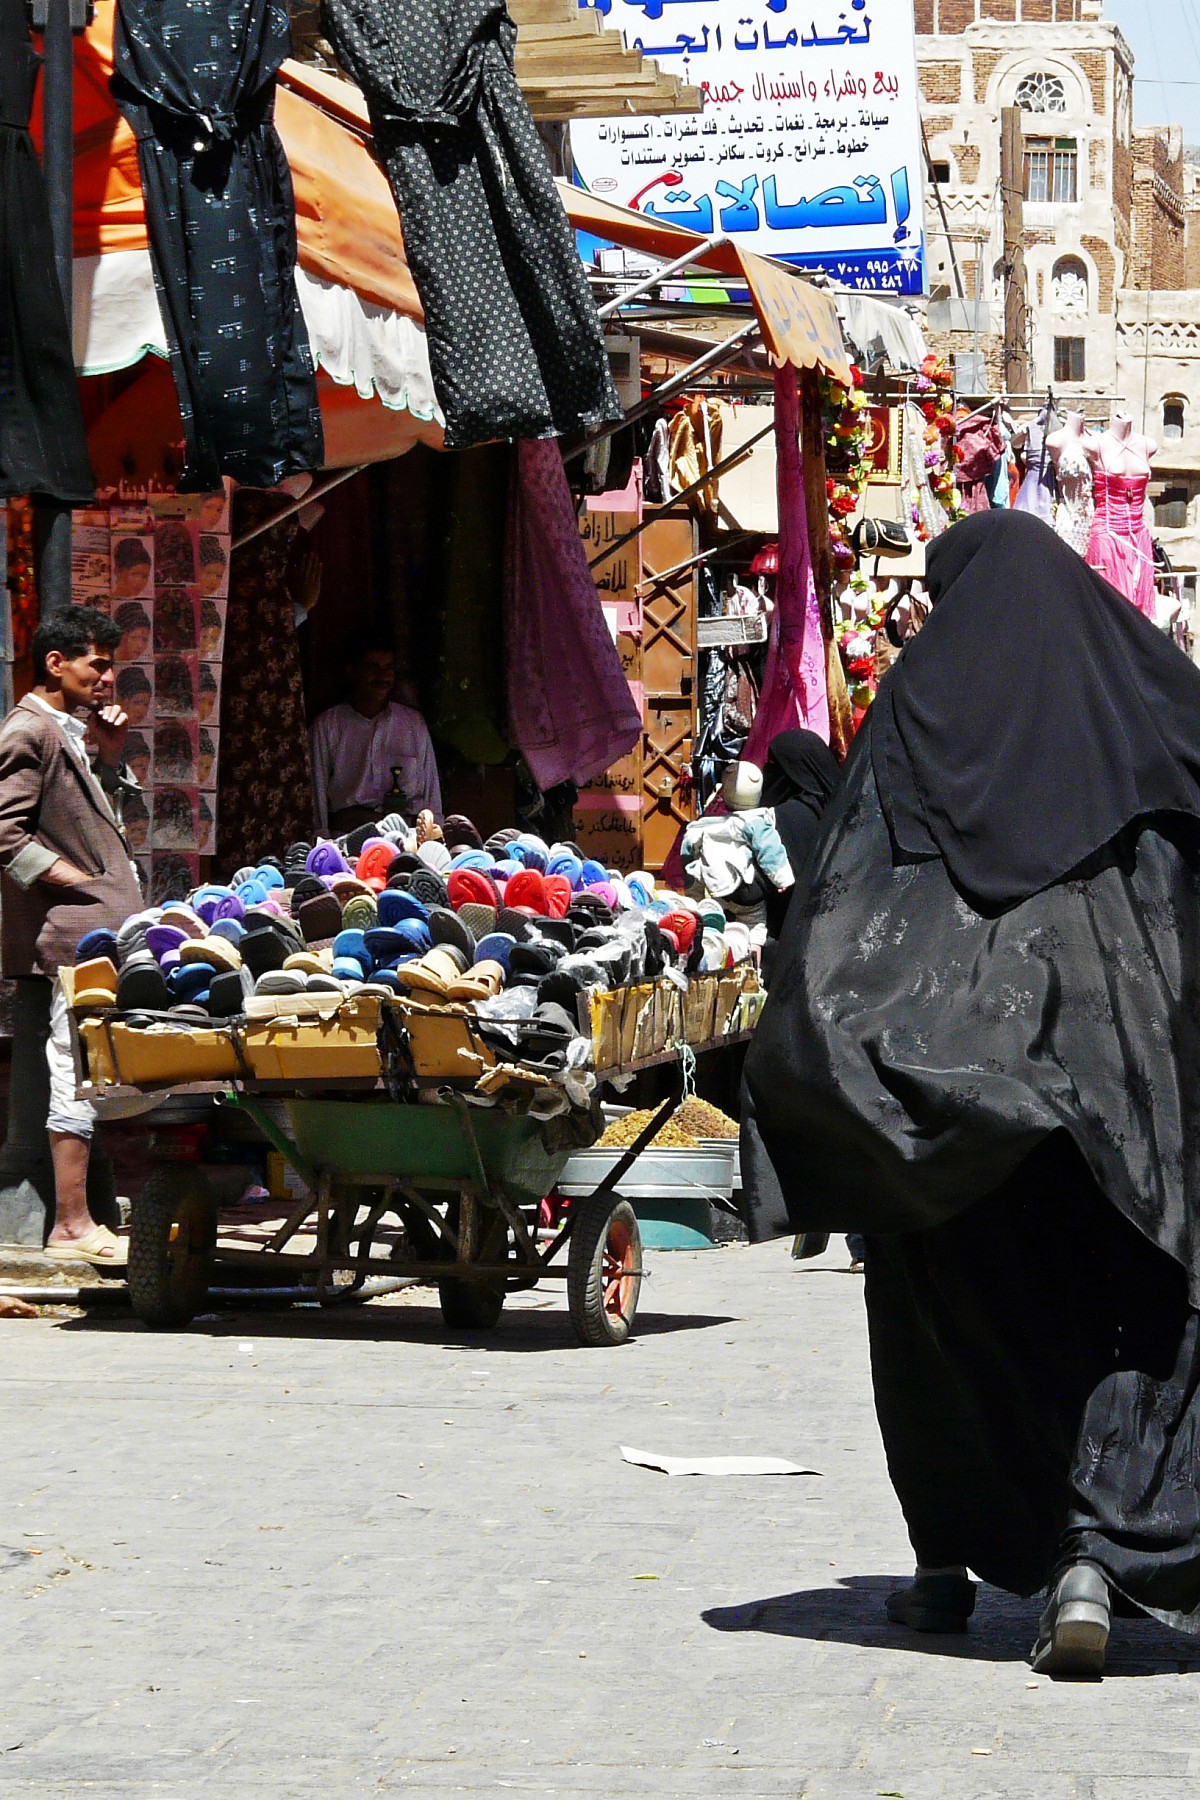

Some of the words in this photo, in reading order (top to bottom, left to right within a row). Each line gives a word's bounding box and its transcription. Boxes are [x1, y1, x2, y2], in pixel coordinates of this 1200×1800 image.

[734, 13, 872, 51] لخدمات
[622, 23, 722, 63] الجوا
[701, 79, 745, 112] جميع
[752, 70, 818, 107] واستبدال
[823, 69, 867, 101] وشراء
[873, 70, 899, 102] بيع
[663, 119, 698, 141] شفرات
[702, 119, 718, 135] فك
[727, 115, 764, 139] تحديث
[775, 115, 805, 132] نغمات
[816, 115, 848, 134] برمجة
[859, 110, 889, 131] صيانة
[717, 144, 746, 165] سكانر
[756, 141, 784, 161] كروت
[836, 135, 869, 154] خطوط
[620, 149, 667, 166] مستندات
[670, 151, 706, 168] تصوير
[643, 166, 912, 243] إتصالات
[866, 260, 889, 274] ٩٩٥
[596, 559, 627, 592] للاتص
